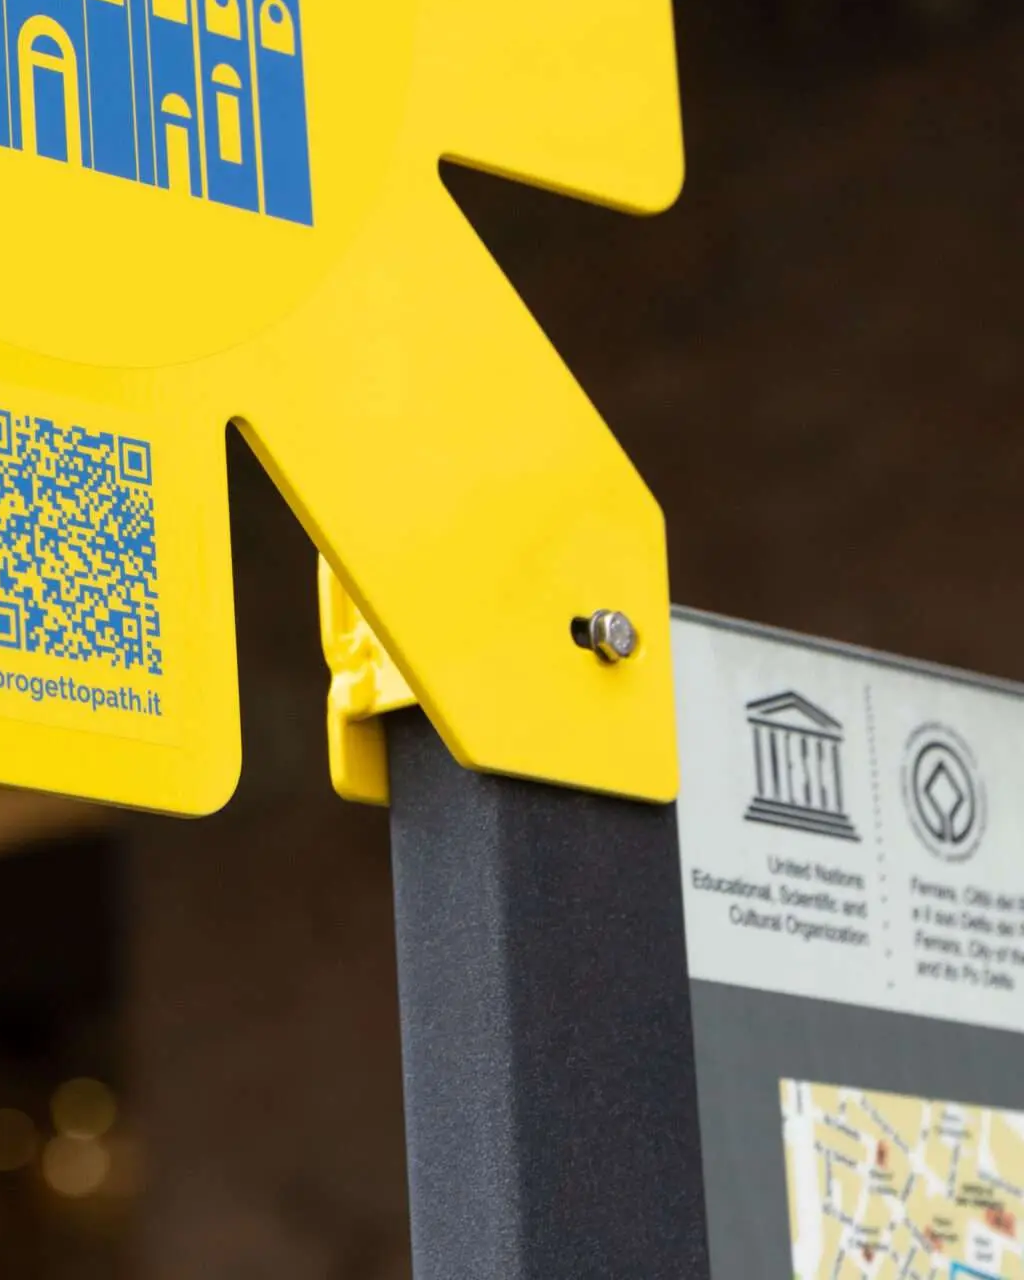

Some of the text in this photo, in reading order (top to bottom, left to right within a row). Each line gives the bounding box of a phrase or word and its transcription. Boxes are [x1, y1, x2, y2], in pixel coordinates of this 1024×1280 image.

[767, 855, 865, 890] United Nations
[779, 884, 838, 914] Scientific
[842, 900, 868, 919] and
[729, 904, 870, 947] Cultural Organization
